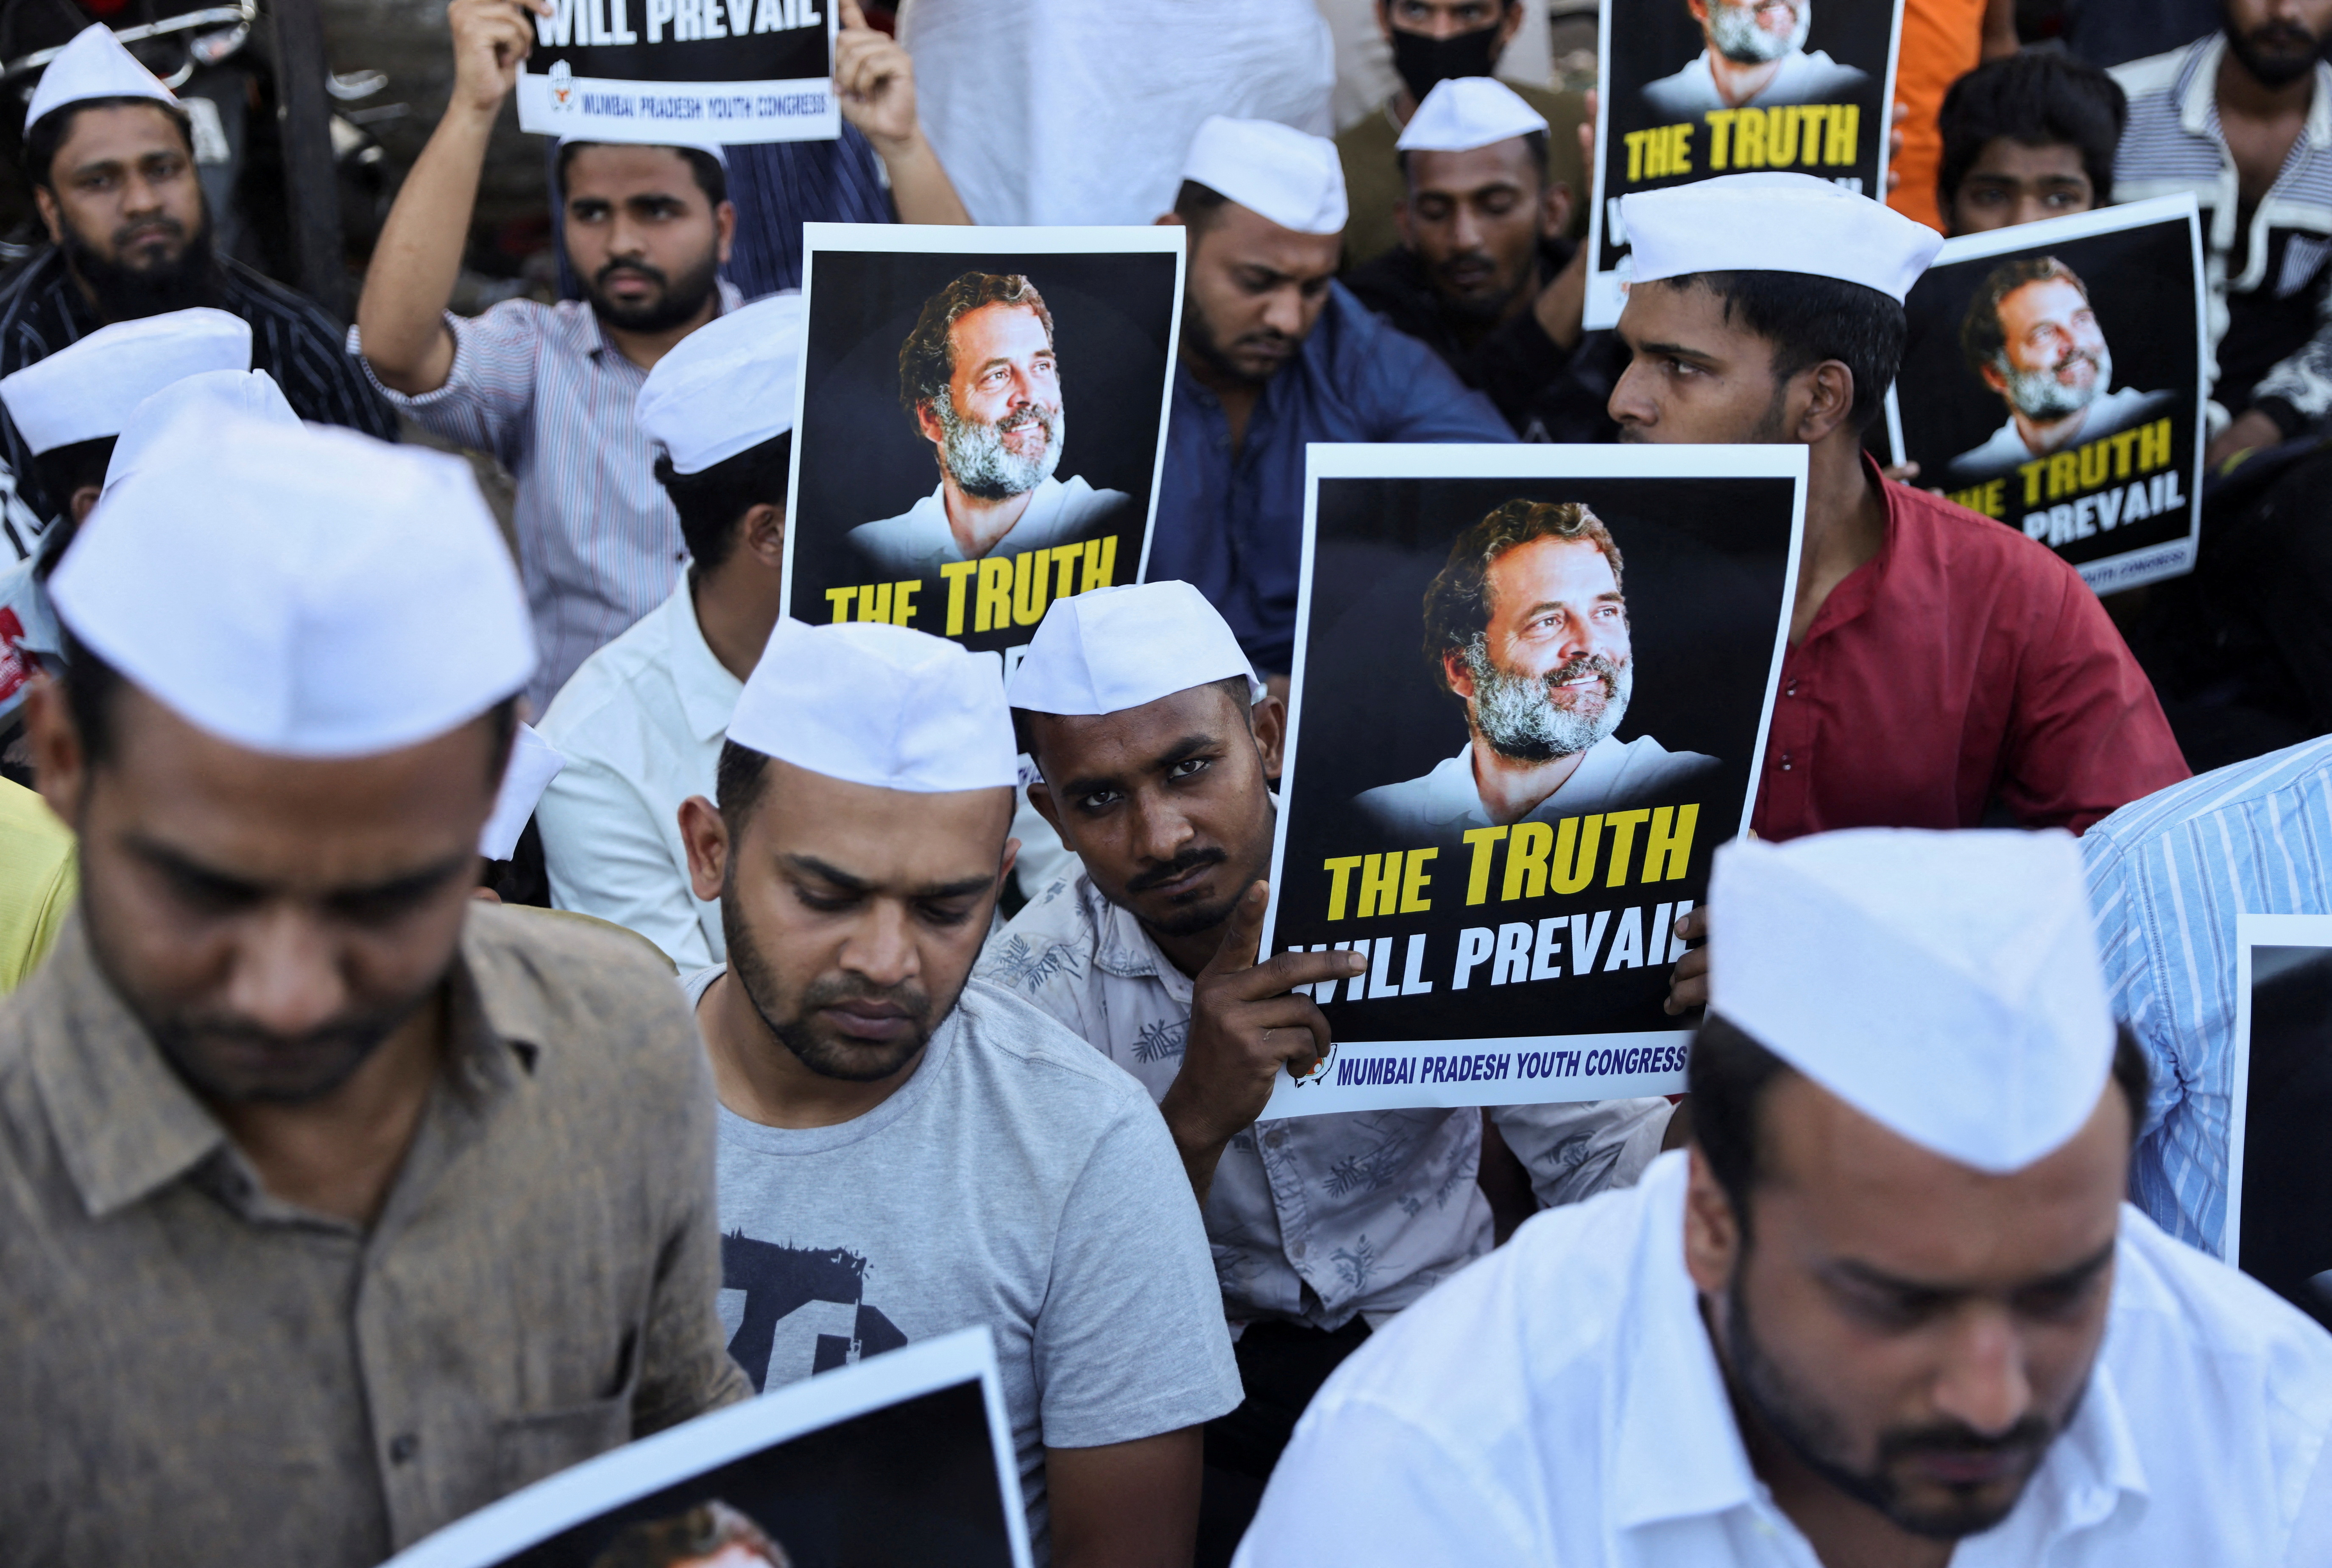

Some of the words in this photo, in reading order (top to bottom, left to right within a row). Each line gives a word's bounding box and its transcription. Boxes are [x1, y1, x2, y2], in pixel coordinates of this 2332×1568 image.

[582, 93, 634, 116] MUMBAI
[640, 94, 702, 118] PRADESH
[709, 95, 753, 118] YOUTH
[756, 90, 828, 117] CONGRESS
[1623, 122, 1695, 182] THE
[1704, 104, 1861, 170] TRUTH
[1946, 477, 2007, 518] HE
[2017, 416, 2172, 507] TRUTH
[2022, 469, 2187, 549] PREVAIL
[825, 579, 922, 631] THE
[940, 535, 1118, 636] TRUTH
[1324, 847, 1438, 921] THE
[1463, 803, 1700, 906] TRUTH
[1337, 1057, 1417, 1086] MUMBAI
[1420, 1053, 1511, 1084] PRADESH
[1517, 1050, 1582, 1079] YOUTH
[1585, 1046, 1687, 1076] CONGRESS
